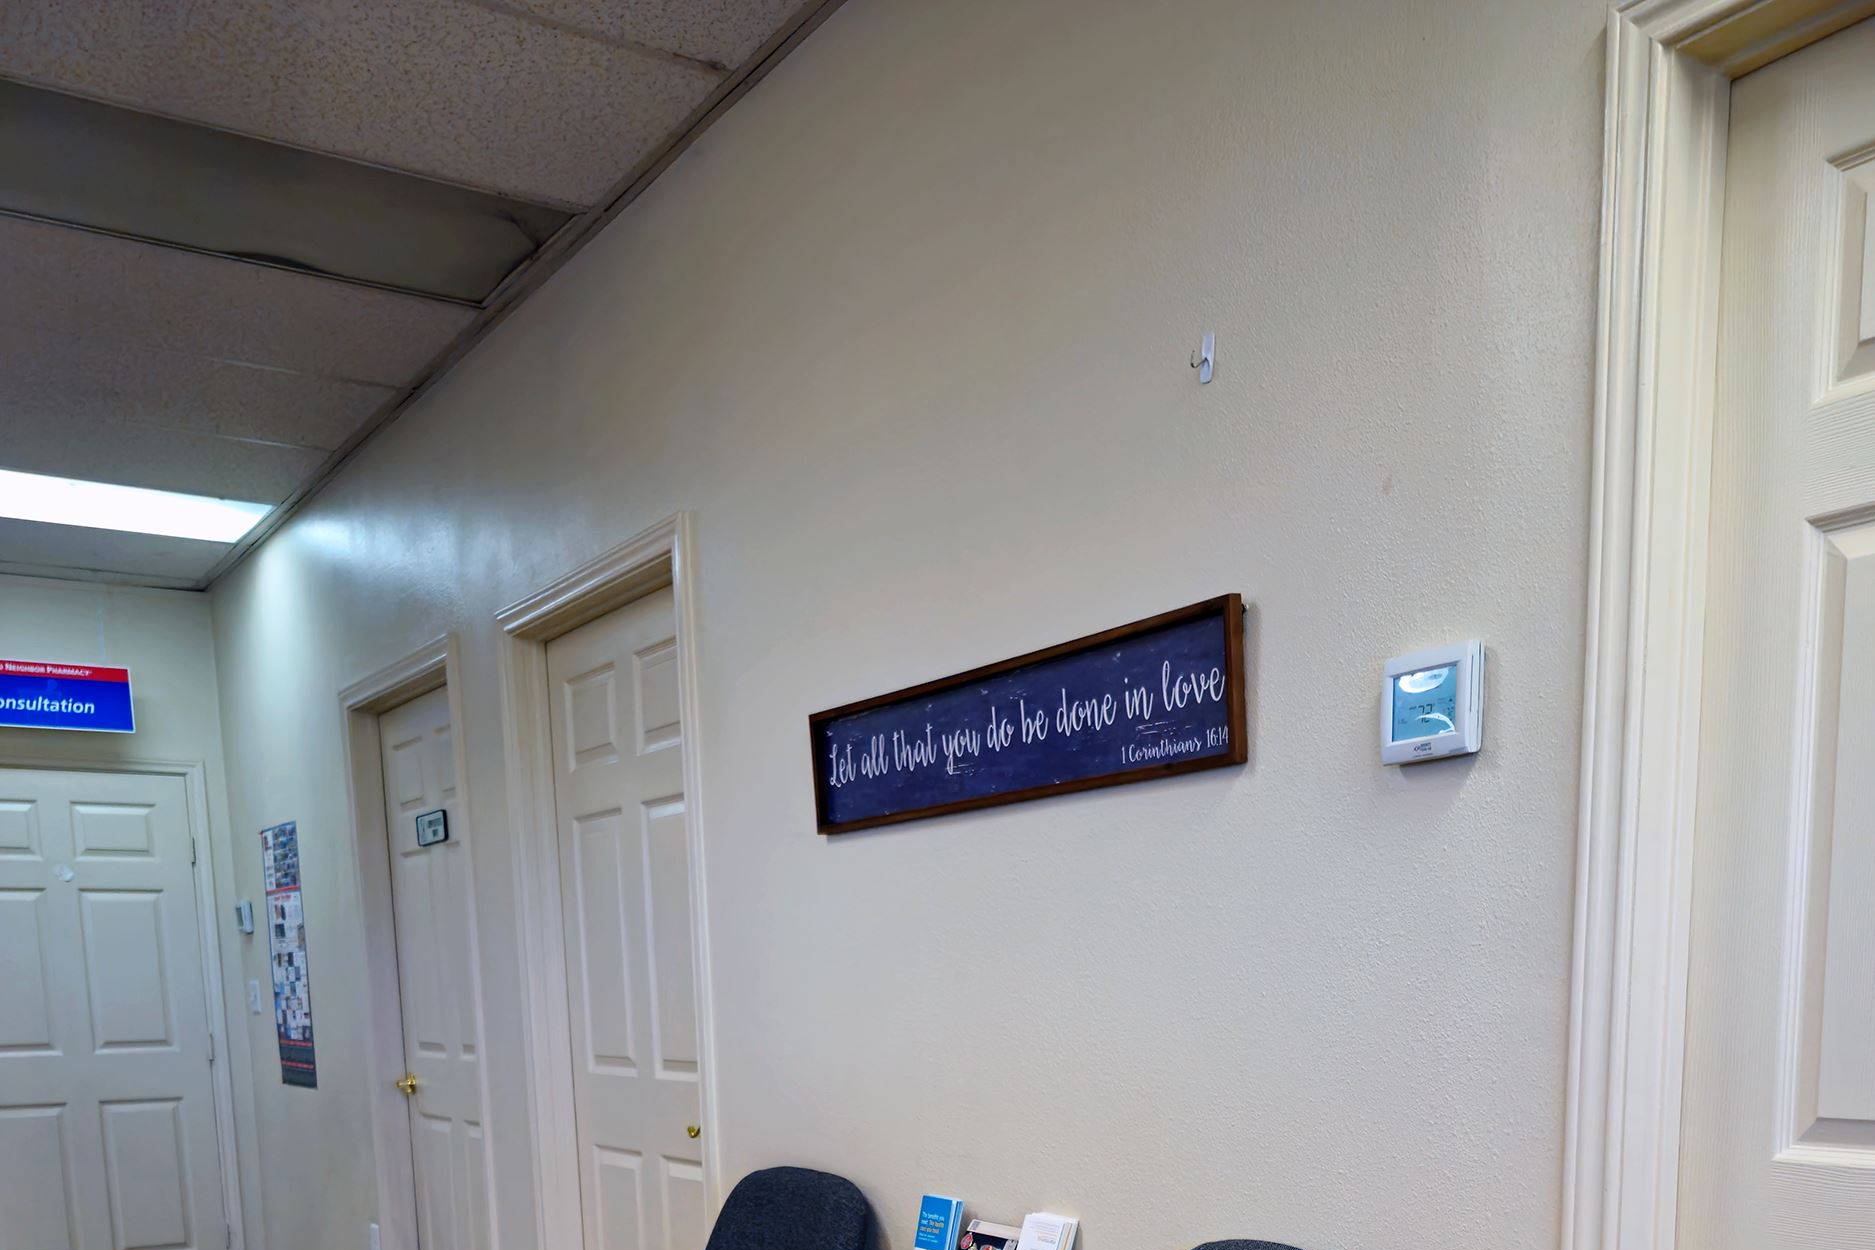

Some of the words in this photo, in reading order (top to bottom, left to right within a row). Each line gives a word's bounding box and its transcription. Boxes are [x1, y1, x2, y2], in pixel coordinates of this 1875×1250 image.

[830, 743, 857, 788] Let
[861, 733, 889, 779] all
[893, 723, 937, 772] that
[942, 728, 981, 775] you
[987, 706, 1014, 752] do
[1020, 699, 1049, 744] be
[1056, 688, 1117, 736] done
[1124, 677, 1154, 721] in
[1161, 660, 1226, 711] love
[1121, 746, 1126, 764] 1
[1128, 736, 1202, 763] Corinthians
[1206, 725, 1229, 748] 16:14
